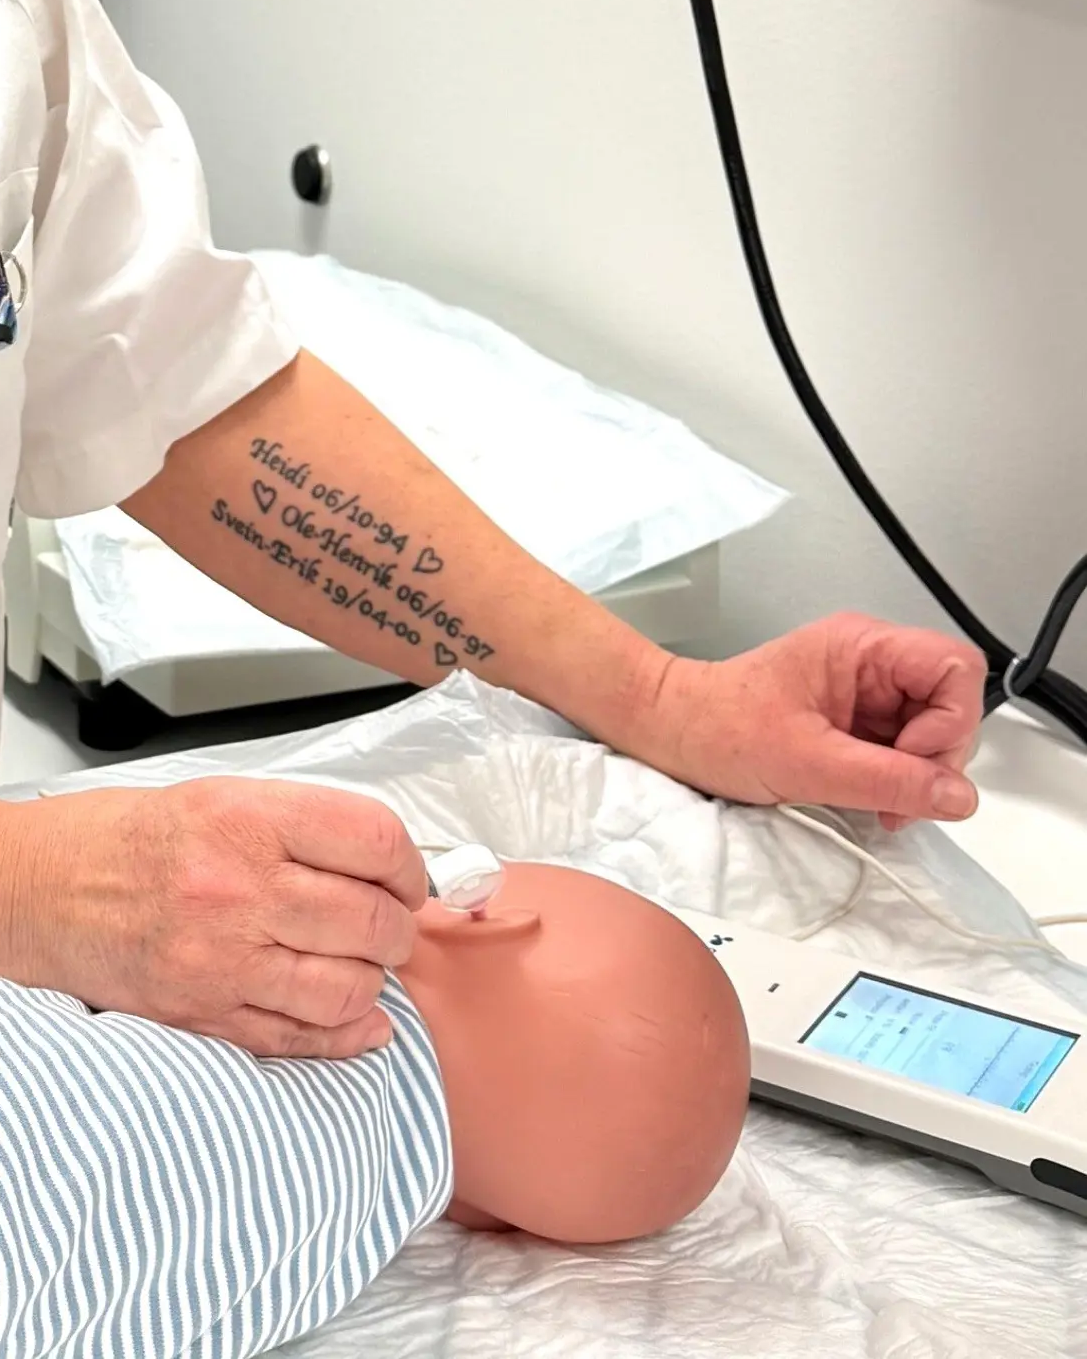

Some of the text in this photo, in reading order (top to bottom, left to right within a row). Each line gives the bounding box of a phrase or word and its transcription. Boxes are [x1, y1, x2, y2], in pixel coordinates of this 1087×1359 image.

[250, 438, 410, 555] Heidi 06/10-94
[211, 498, 421, 646] Svein-Erik 19/04-00
[281, 504, 496, 662] Ole-Henrik 06/06-97
